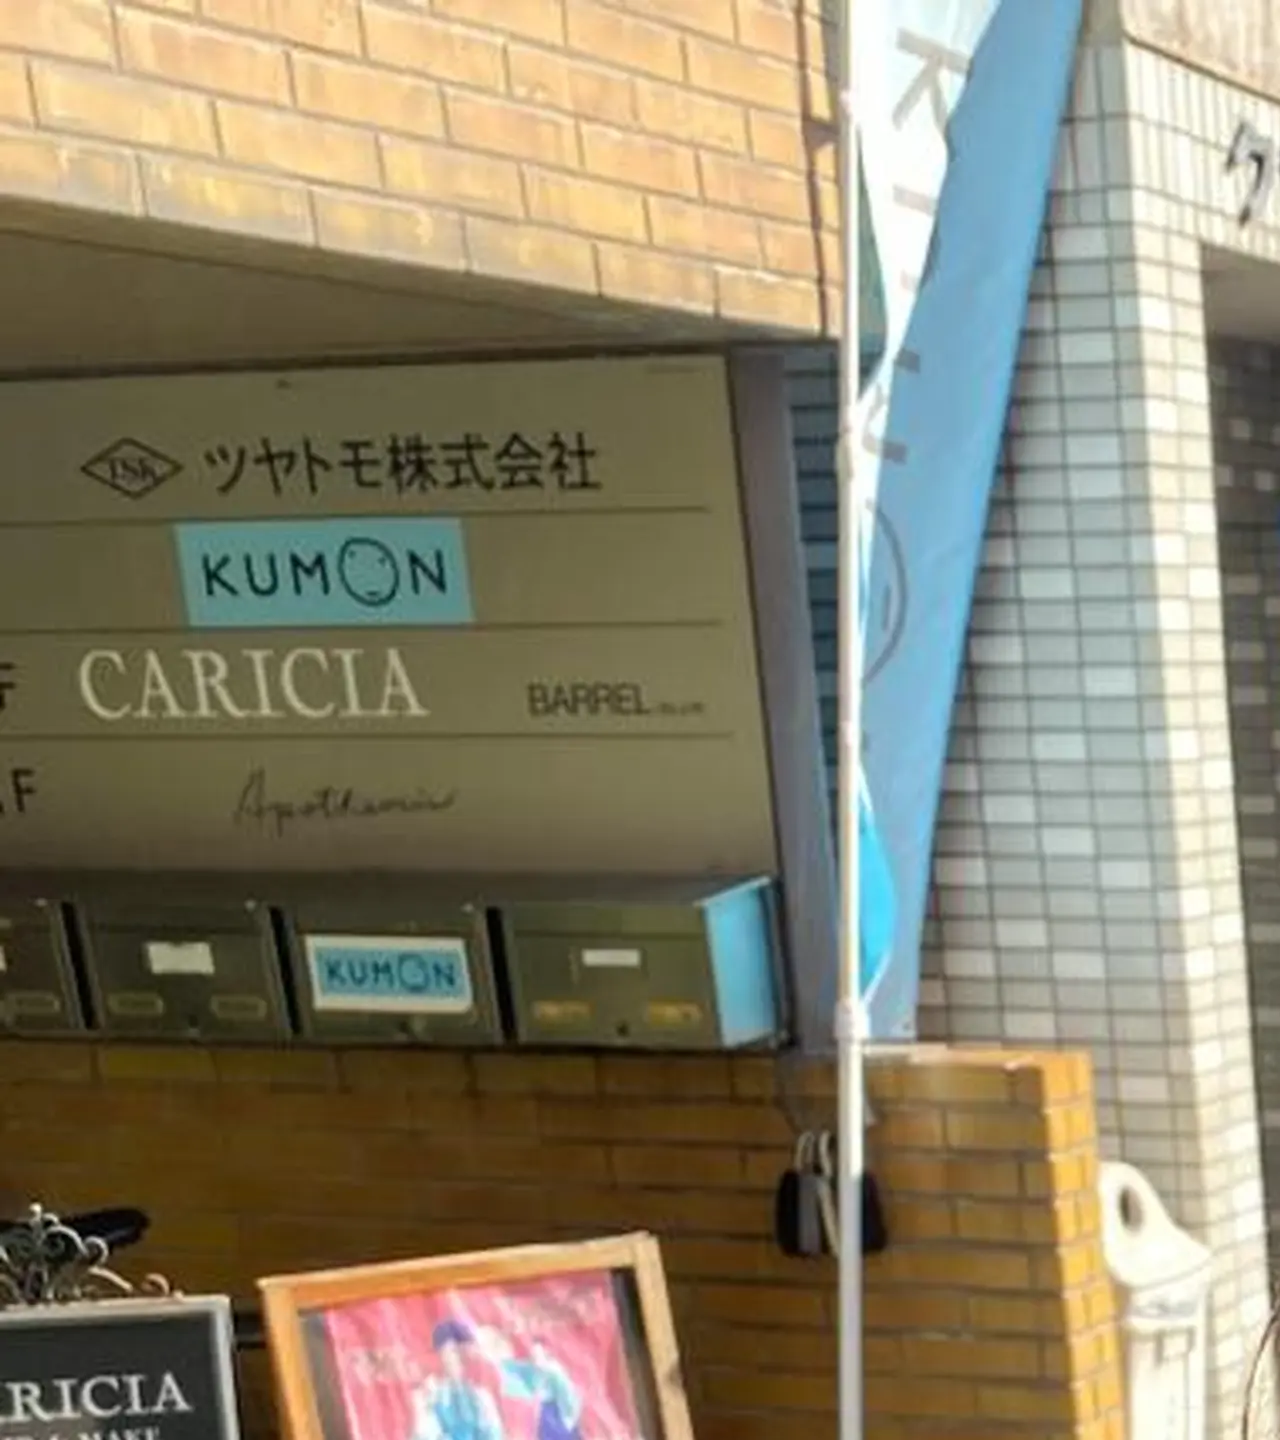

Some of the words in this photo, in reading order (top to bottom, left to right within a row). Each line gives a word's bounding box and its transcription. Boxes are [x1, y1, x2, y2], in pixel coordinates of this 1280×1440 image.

[204, 432, 602, 497] ツヤトモ株式会社
[202, 536, 448, 607] KUMON
[79, 648, 430, 720] CARICIA
[527, 681, 651, 718] BARREL
[326, 953, 456, 992] KUMON
[0, 1371, 192, 1422] RICIA
